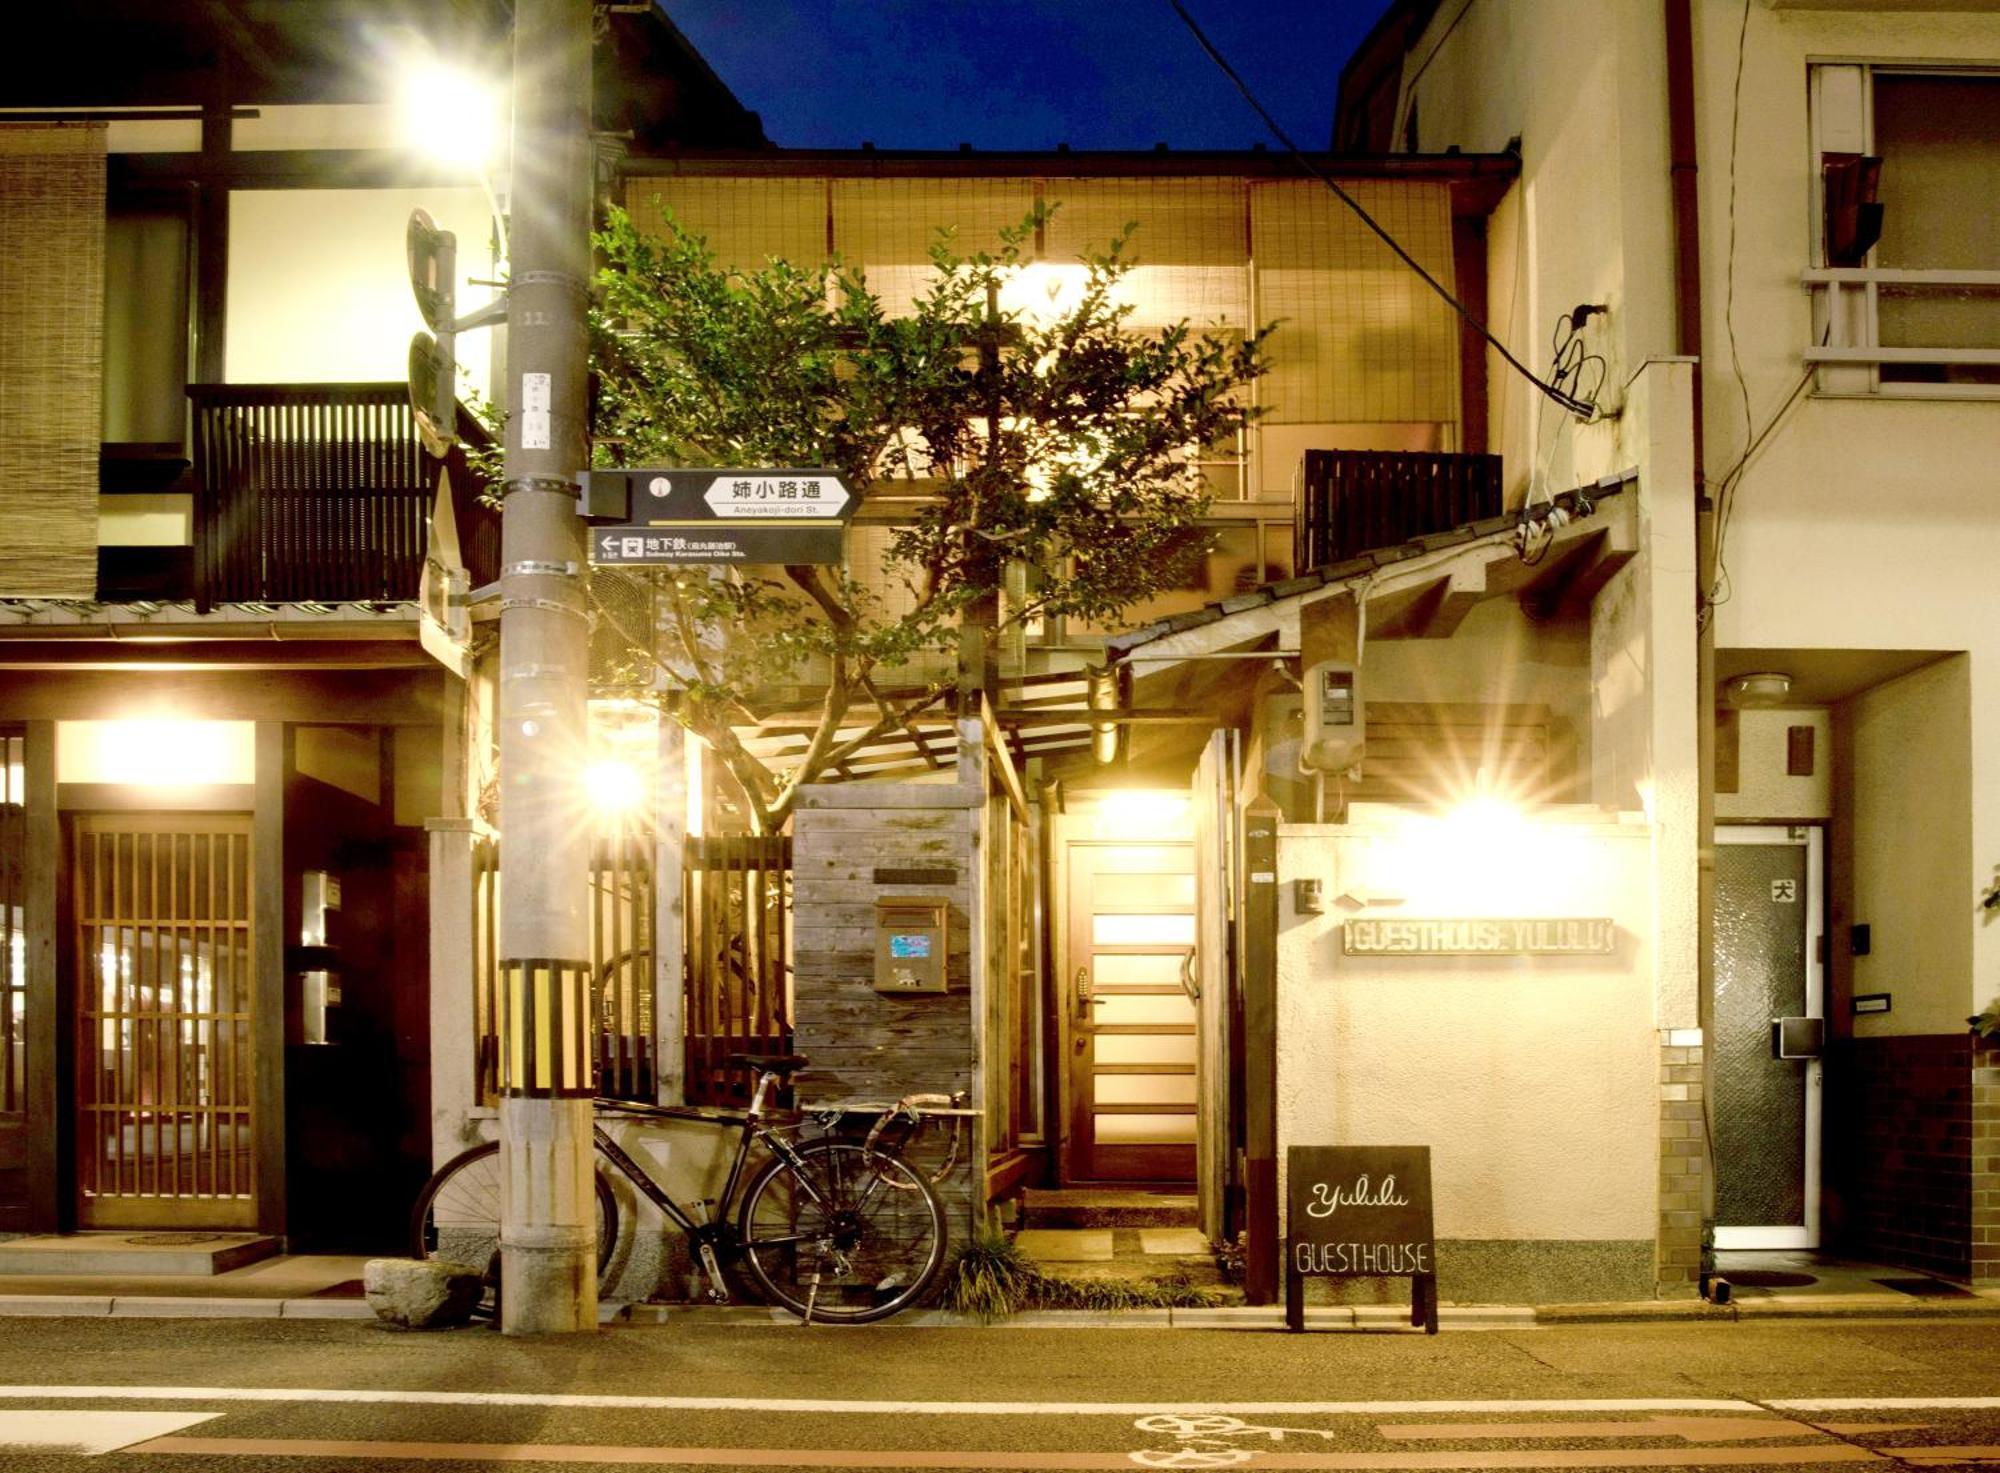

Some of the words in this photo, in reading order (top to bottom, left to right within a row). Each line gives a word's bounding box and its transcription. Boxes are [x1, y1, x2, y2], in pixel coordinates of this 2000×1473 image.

[732, 480, 821, 499] 姉小路通
[733, 505, 803, 515] Aneyakoji-dori
[805, 504, 820, 515] St.
[1774, 881, 1793, 899] 犬
[1354, 921, 1508, 951] GUESTHOUSE
[1511, 921, 1603, 951] YULULU
[1296, 1243, 1430, 1273] GUESTHOUSE
